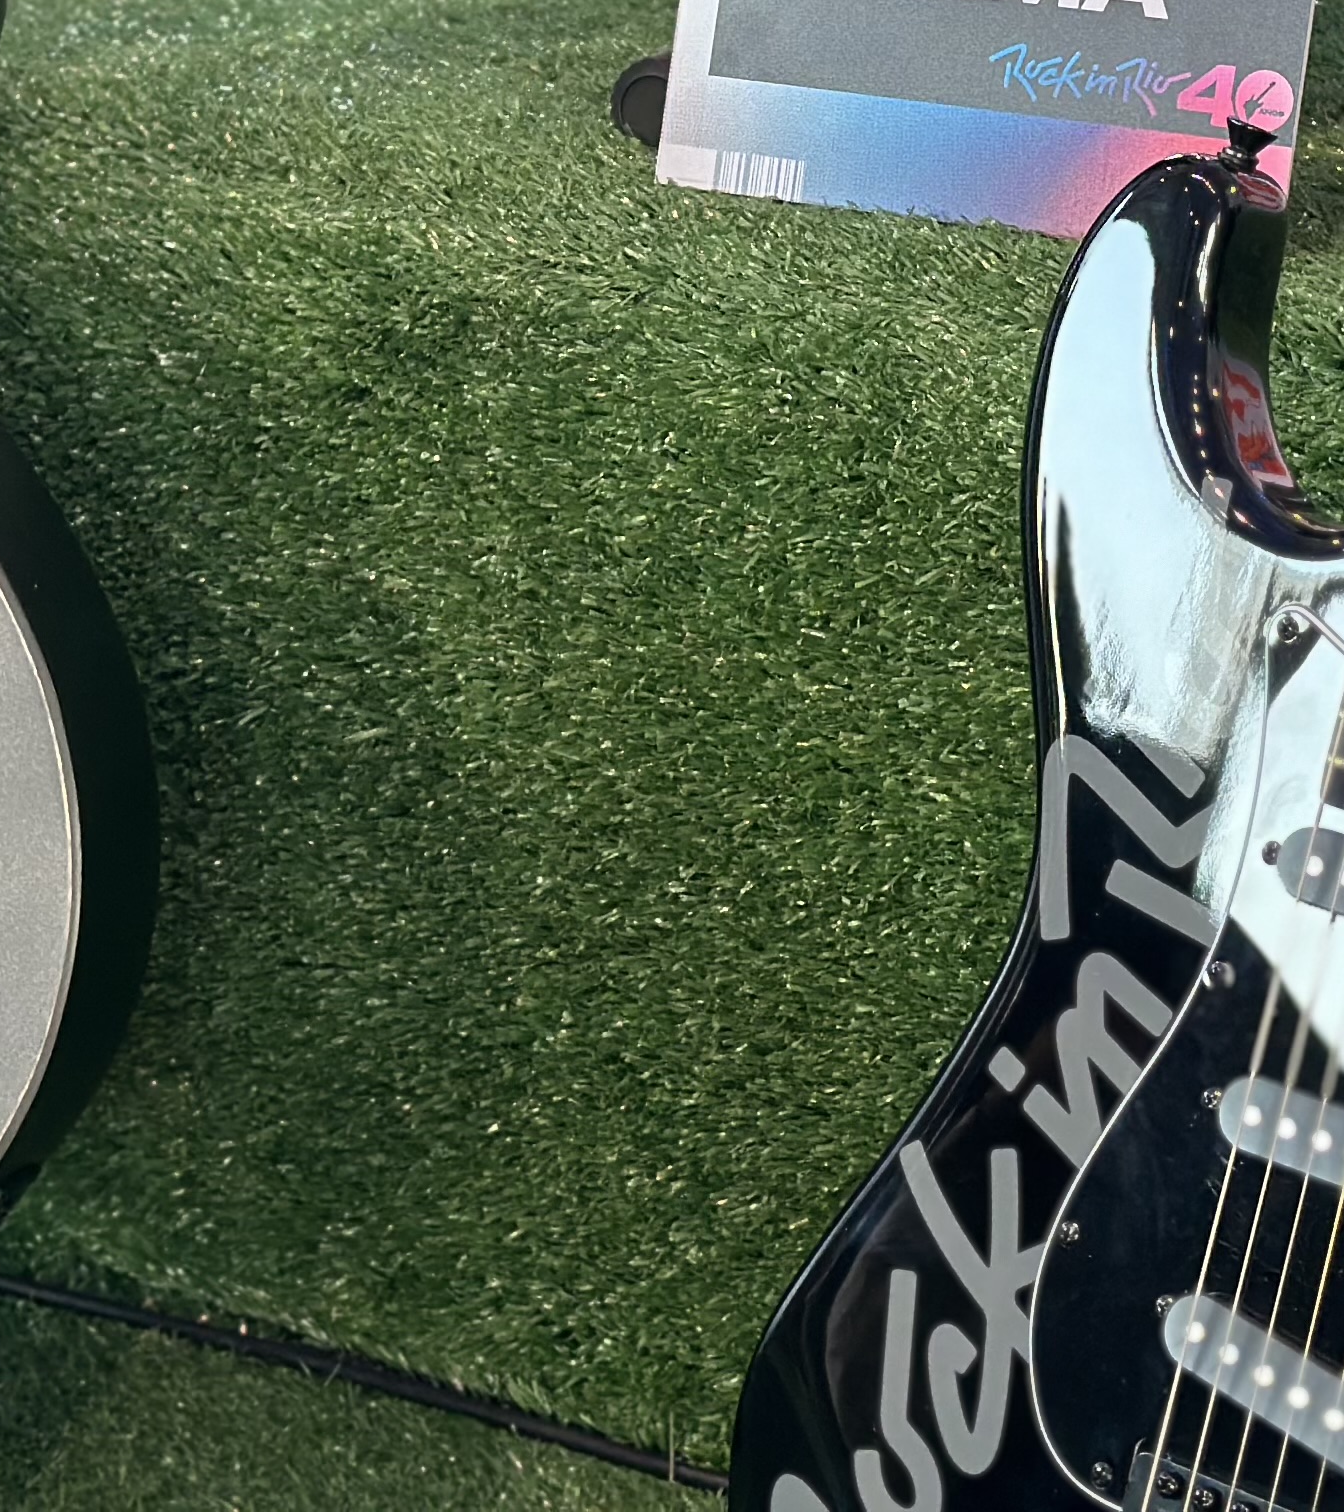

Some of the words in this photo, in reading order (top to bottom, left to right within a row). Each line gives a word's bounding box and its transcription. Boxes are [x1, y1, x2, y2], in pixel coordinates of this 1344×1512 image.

[988, 43, 1086, 103] Rock
[1084, 64, 1118, 96] in
[1116, 57, 1192, 117] Rio
[770, 1140, 1050, 1512] ock
